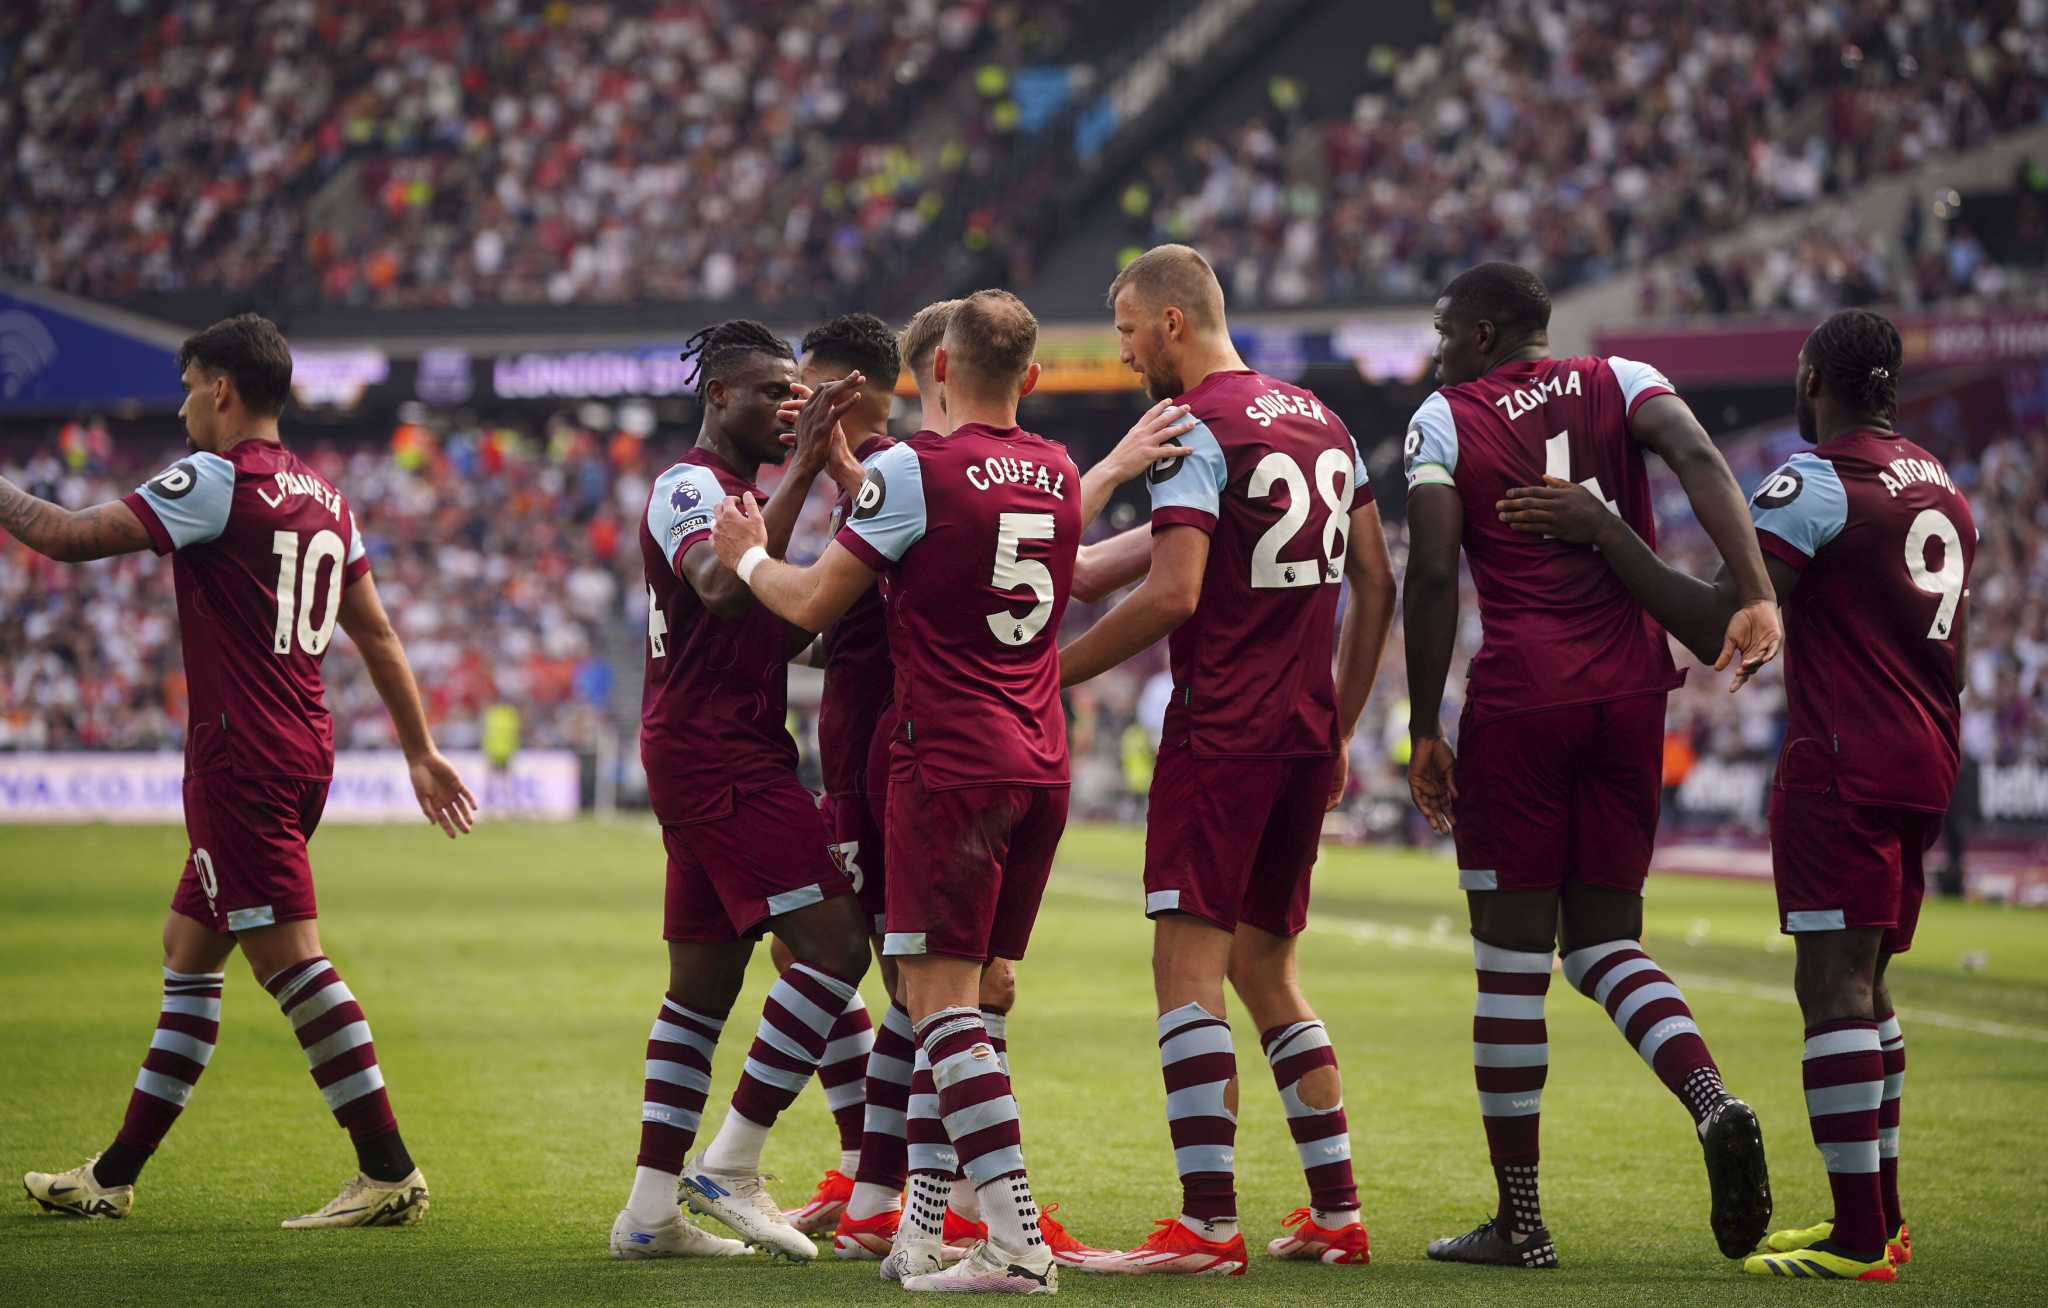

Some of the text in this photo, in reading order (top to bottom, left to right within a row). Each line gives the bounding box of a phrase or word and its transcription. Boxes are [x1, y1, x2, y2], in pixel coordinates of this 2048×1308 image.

[966, 457, 1065, 501] COUFAL
[1248, 449, 1355, 588] 28
[272, 529, 345, 656] 10
[986, 512, 1055, 646] 5
[1905, 509, 1964, 640] 9
